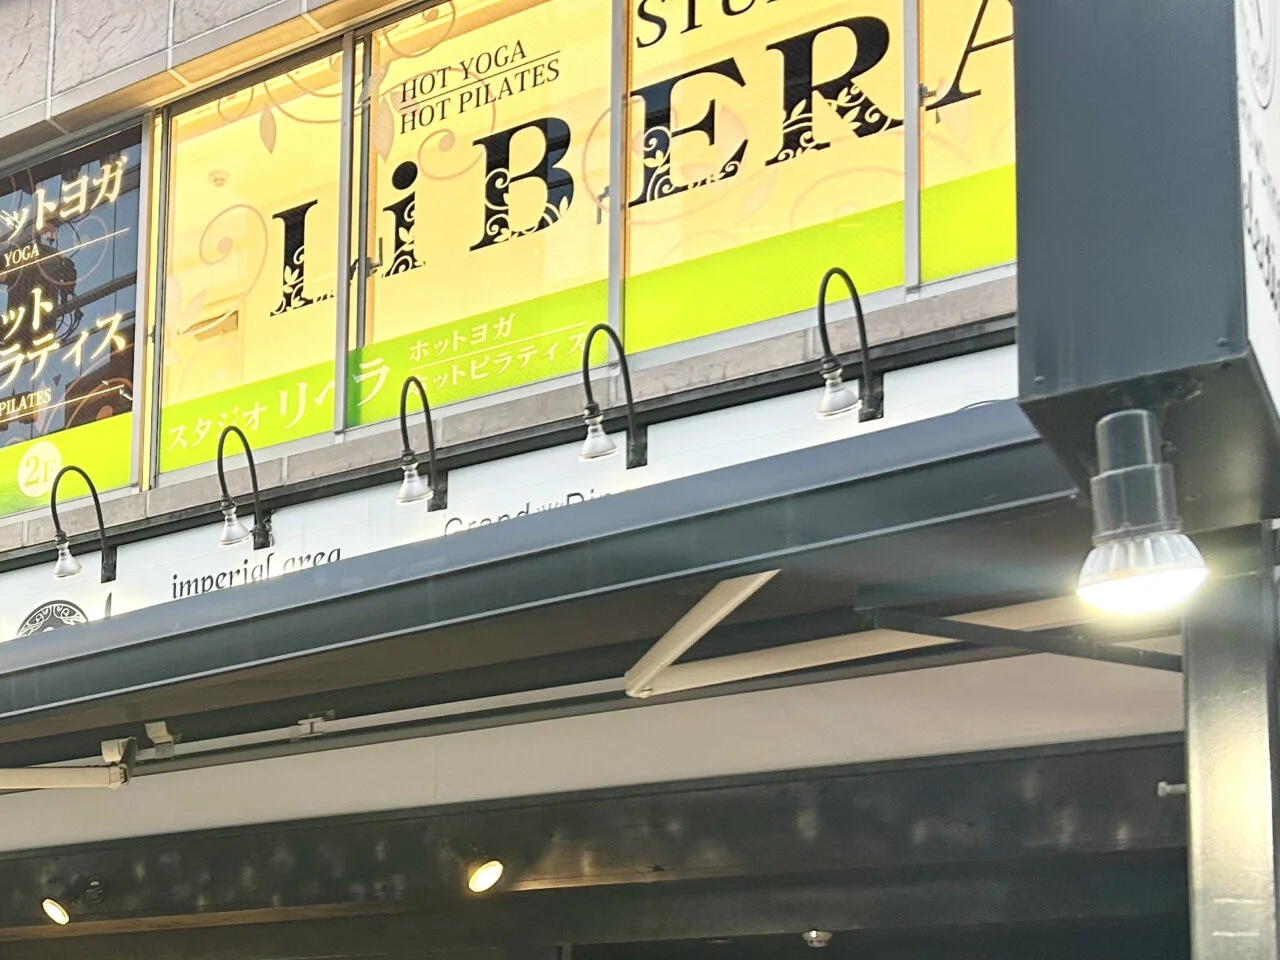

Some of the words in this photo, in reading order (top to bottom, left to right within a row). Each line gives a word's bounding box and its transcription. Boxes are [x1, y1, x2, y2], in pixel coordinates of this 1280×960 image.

[399, 102, 448, 135] HOT
[458, 57, 561, 115] PILATES
[400, 69, 448, 104] HOT
[463, 38, 527, 82] YOGA
[3, 243, 40, 270] YOGA
[408, 312, 517, 363] ホットヨガ
[408, 332, 588, 399] ホットピラティス
[165, 403, 267, 454] スタジオ
[24, 455, 57, 487] 2F
